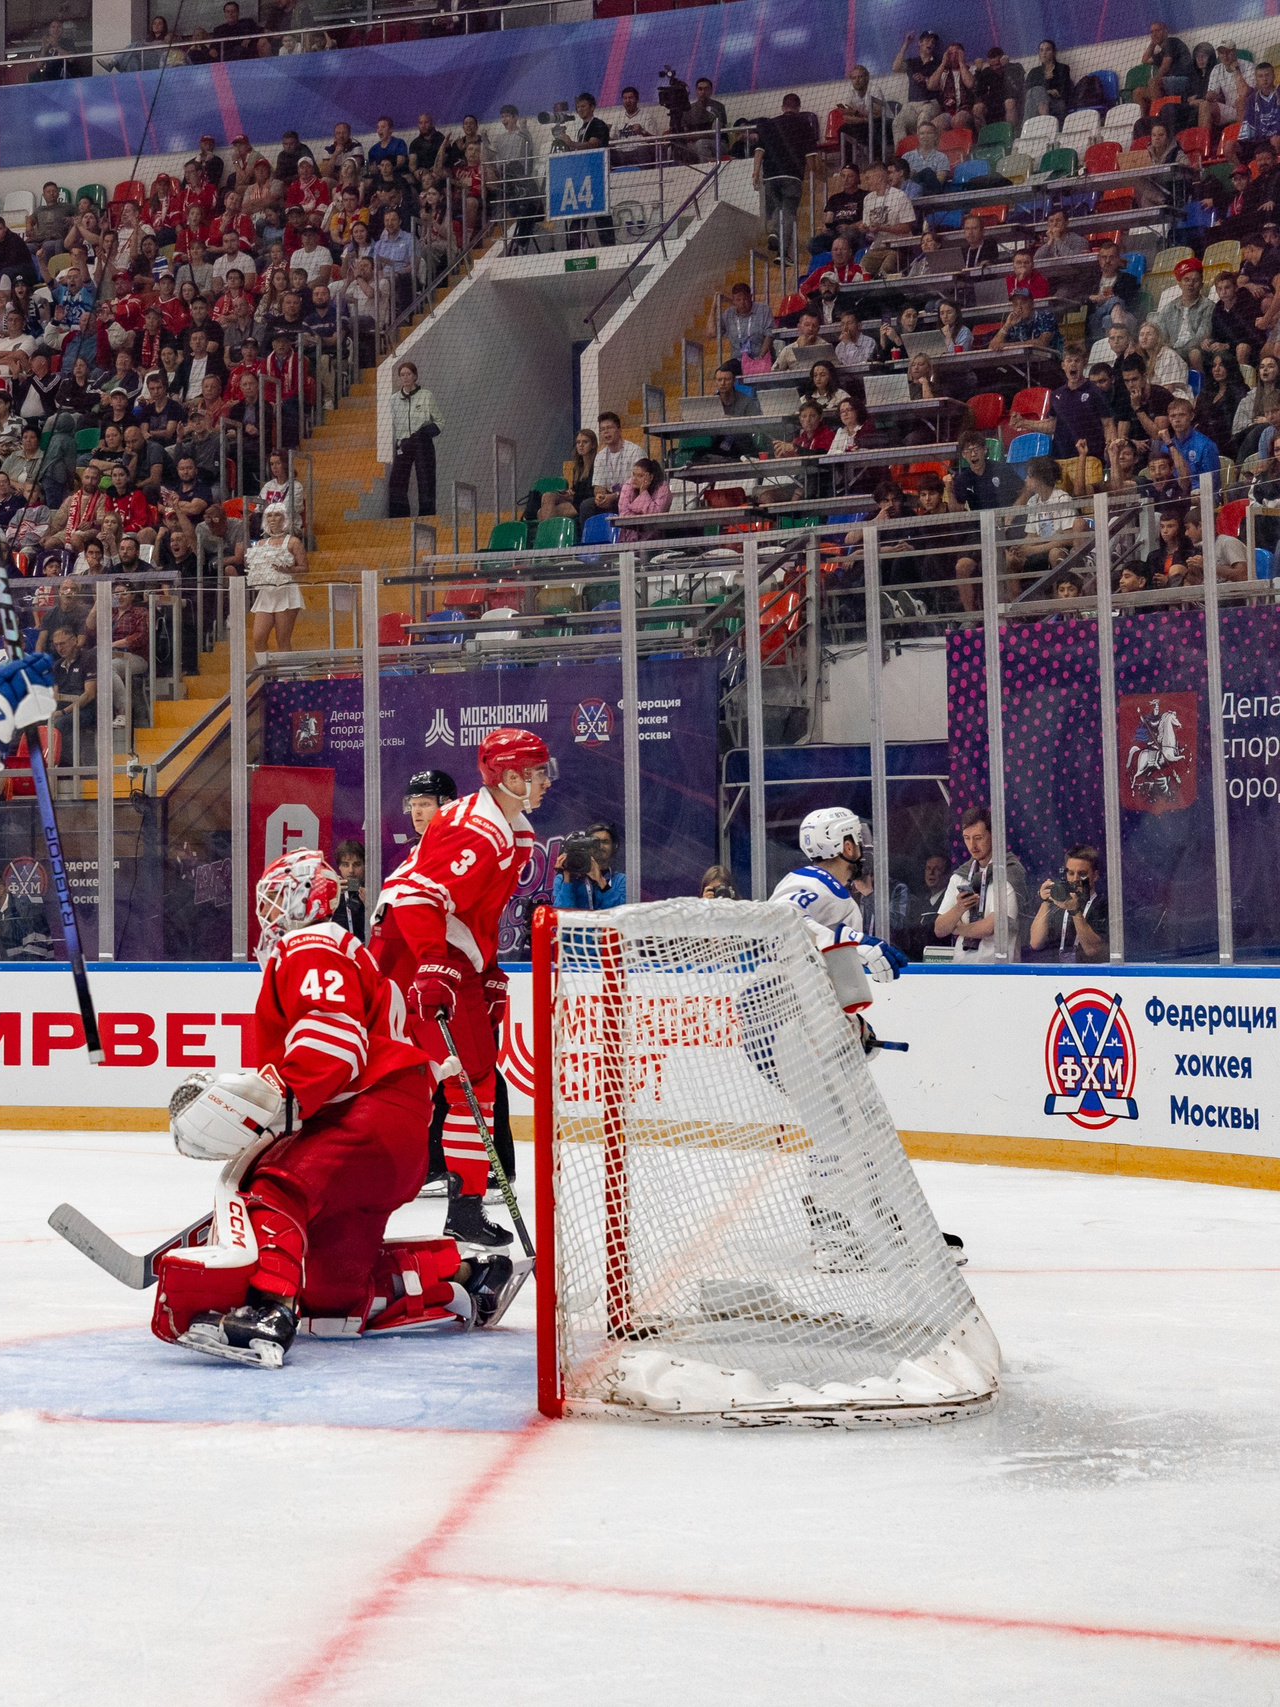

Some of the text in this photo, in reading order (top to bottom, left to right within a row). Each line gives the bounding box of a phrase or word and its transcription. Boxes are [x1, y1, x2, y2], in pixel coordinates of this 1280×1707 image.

[560, 175, 594, 212] A4
[330, 709, 396, 723] Департент
[460, 699, 548, 726] МОСКОВСКИЙ
[637, 715, 668, 725] оккея
[330, 724, 364, 736] спорта
[460, 726, 502, 747] СПО
[577, 721, 608, 733] ФХМ
[638, 730, 670, 740] осквы
[330, 737, 405, 750] города осквы
[1225, 777, 1280, 807] оро
[472, 817, 505, 849] OLIMPBET
[65, 860, 120, 871] едерая
[450, 849, 477, 876] 3
[8, 882, 41, 895] ФХМ
[45, 825, 75, 927] RIBCOR
[73, 895, 99, 904] оскв
[300, 968, 346, 1003] 42
[1145, 995, 1277, 1036] Федерация
[1057, 1055, 1125, 1092] ФХМ
[1174, 1053, 1252, 1079] хоккея
[1170, 1095, 1260, 1130] Москвы
[229, 1200, 247, 1249] CCM
